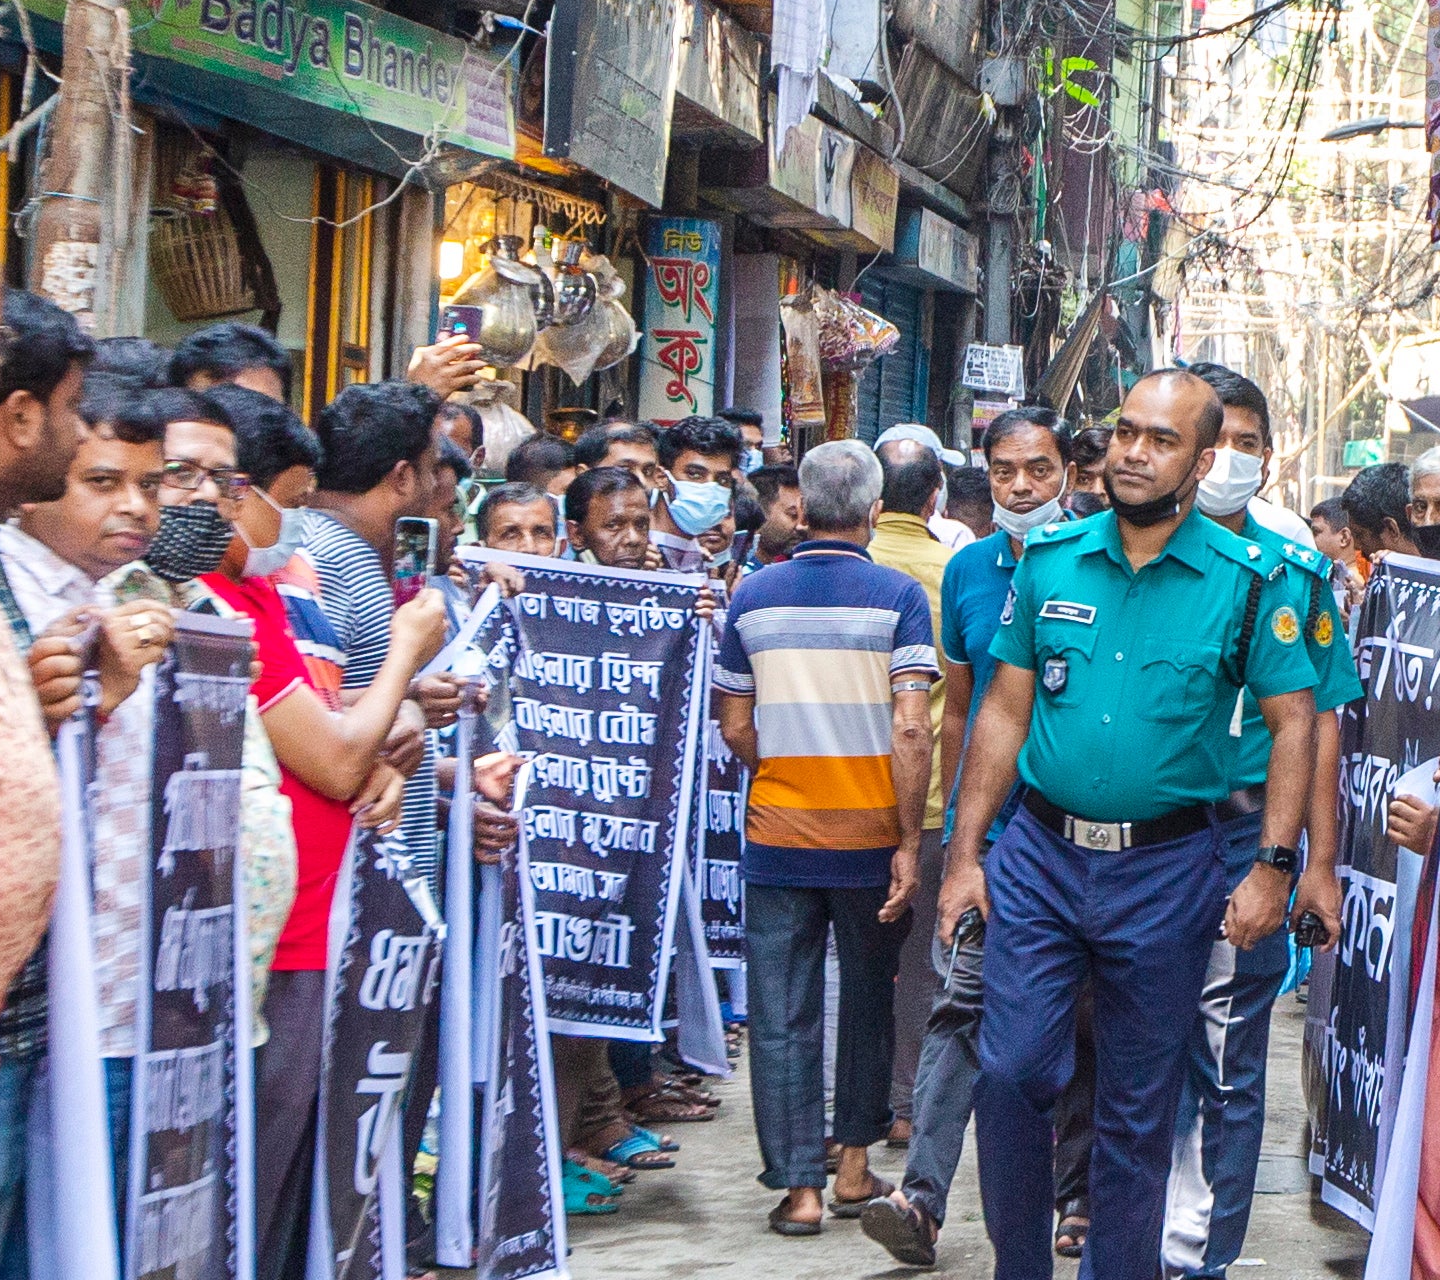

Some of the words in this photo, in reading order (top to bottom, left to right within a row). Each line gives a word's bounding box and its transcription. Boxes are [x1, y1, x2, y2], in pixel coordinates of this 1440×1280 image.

[663, 230, 703, 252] নিউ
[652, 257, 714, 324] আং
[651, 328, 705, 417] কু
[554, 594, 599, 626] আজ
[513, 696, 594, 748] বাংলার
